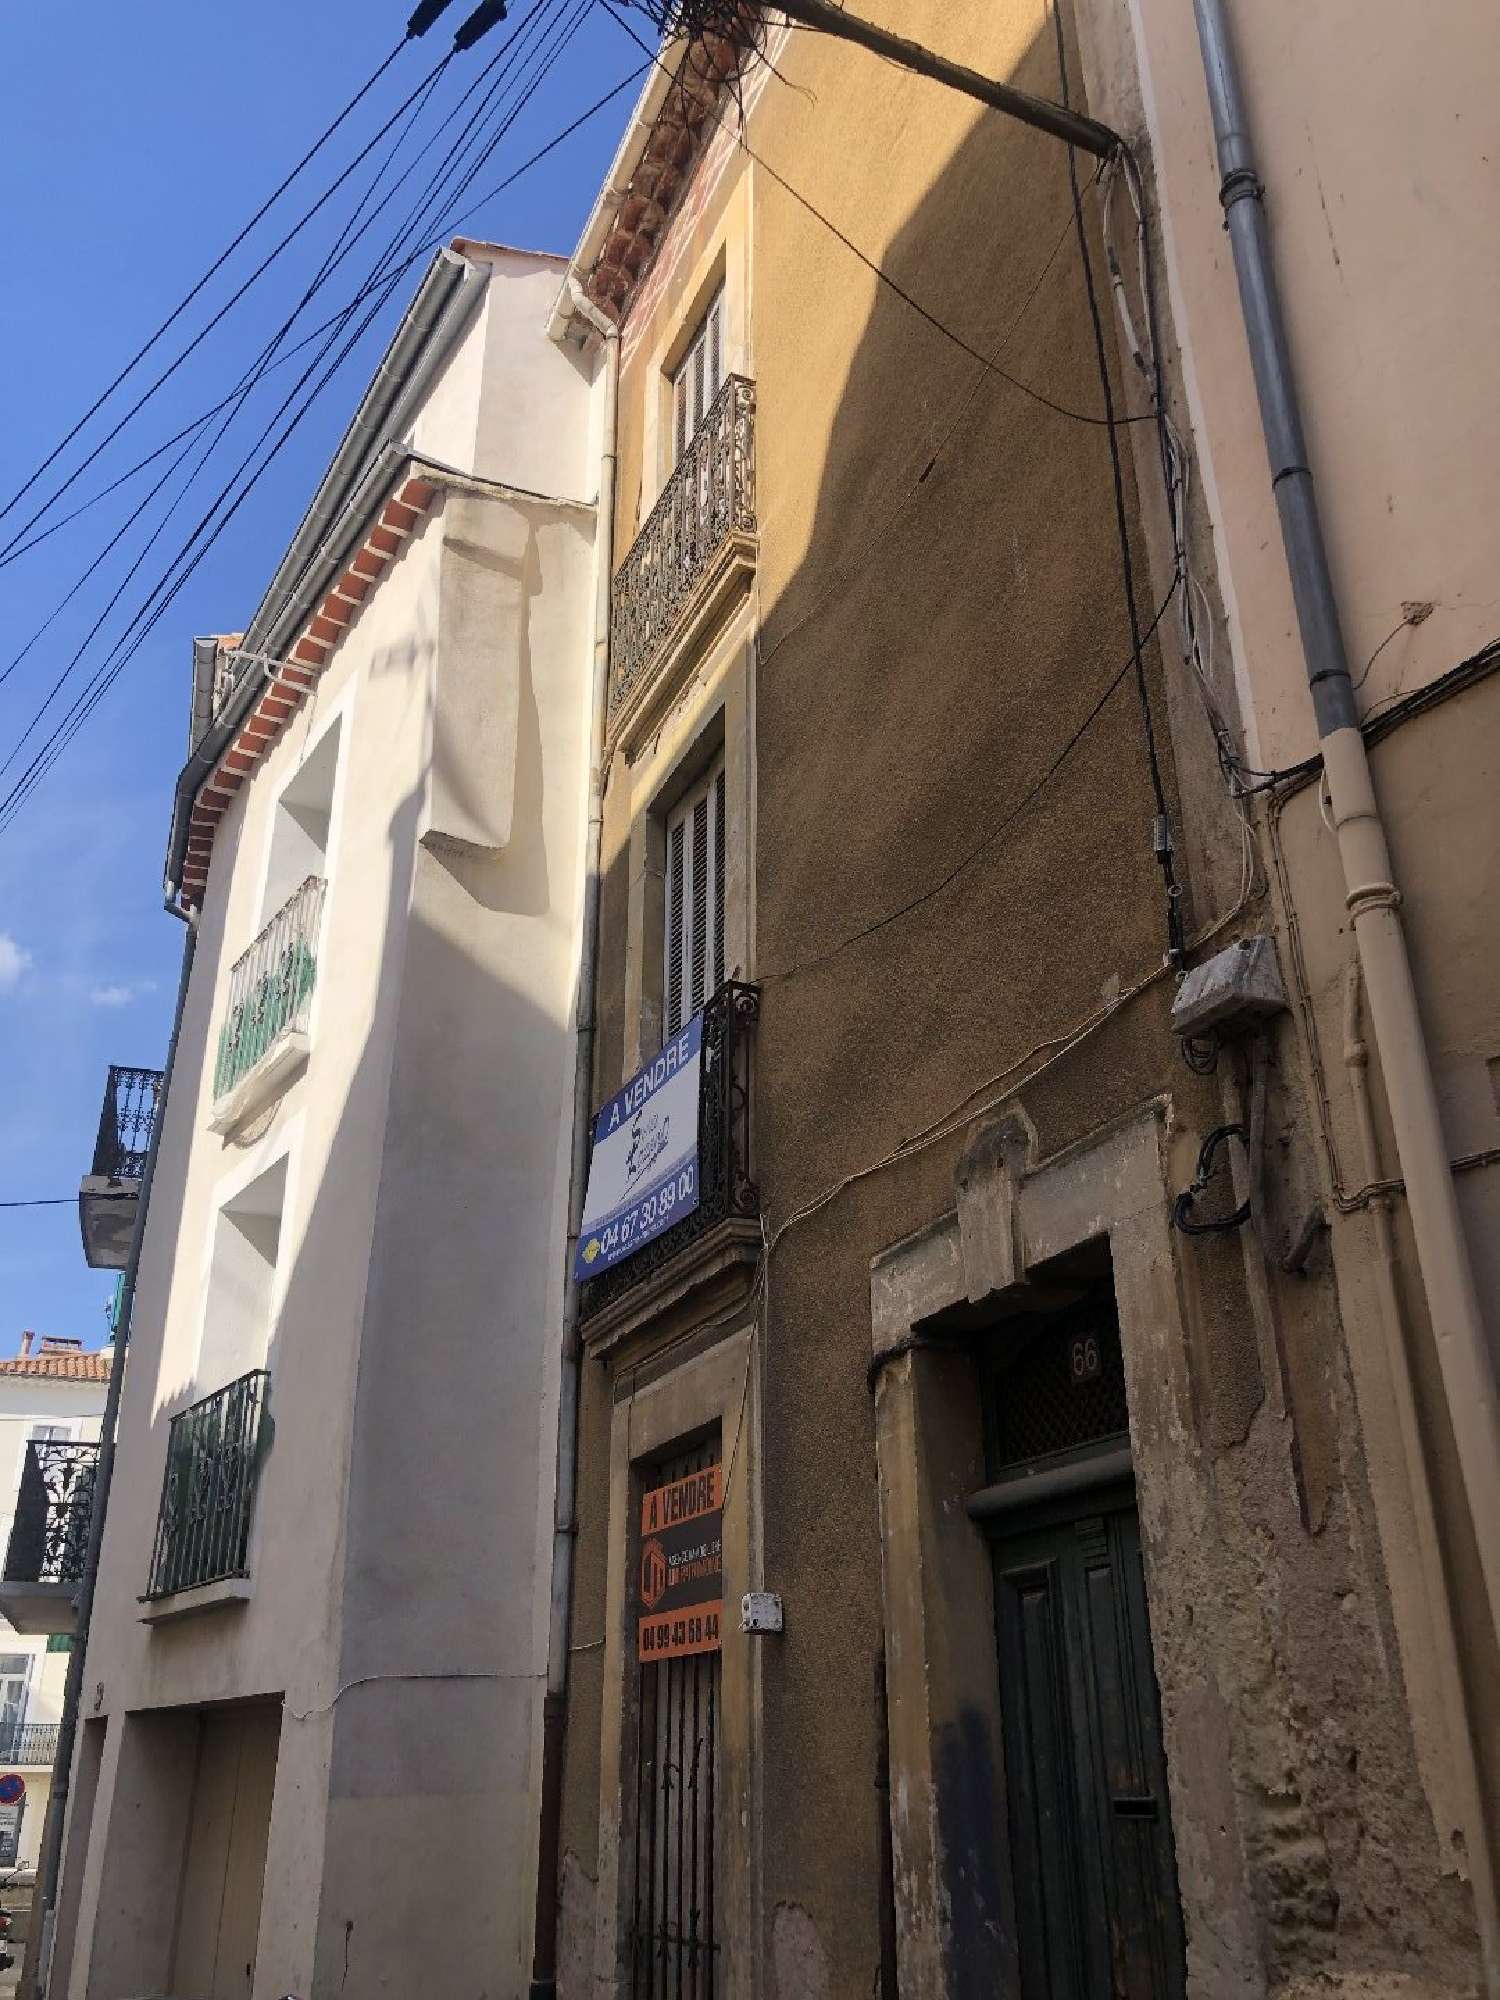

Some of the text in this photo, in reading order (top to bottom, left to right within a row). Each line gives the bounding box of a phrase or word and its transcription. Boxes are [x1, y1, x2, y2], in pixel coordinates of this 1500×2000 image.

[608, 1102, 620, 1132] A
[624, 1032, 690, 1115] VENDRE
[600, 1222, 618, 1255] 04
[621, 1209, 638, 1243] 67
[640, 1196, 657, 1229] 30
[659, 1182, 676, 1217] 89
[678, 1164, 694, 1200] 00
[1073, 1338, 1098, 1376] 66
[650, 1473, 714, 1528] A VENDRE
[657, 1623, 670, 1650] 99
[672, 1620, 686, 1646] 43
[705, 1613, 719, 1640] 44
